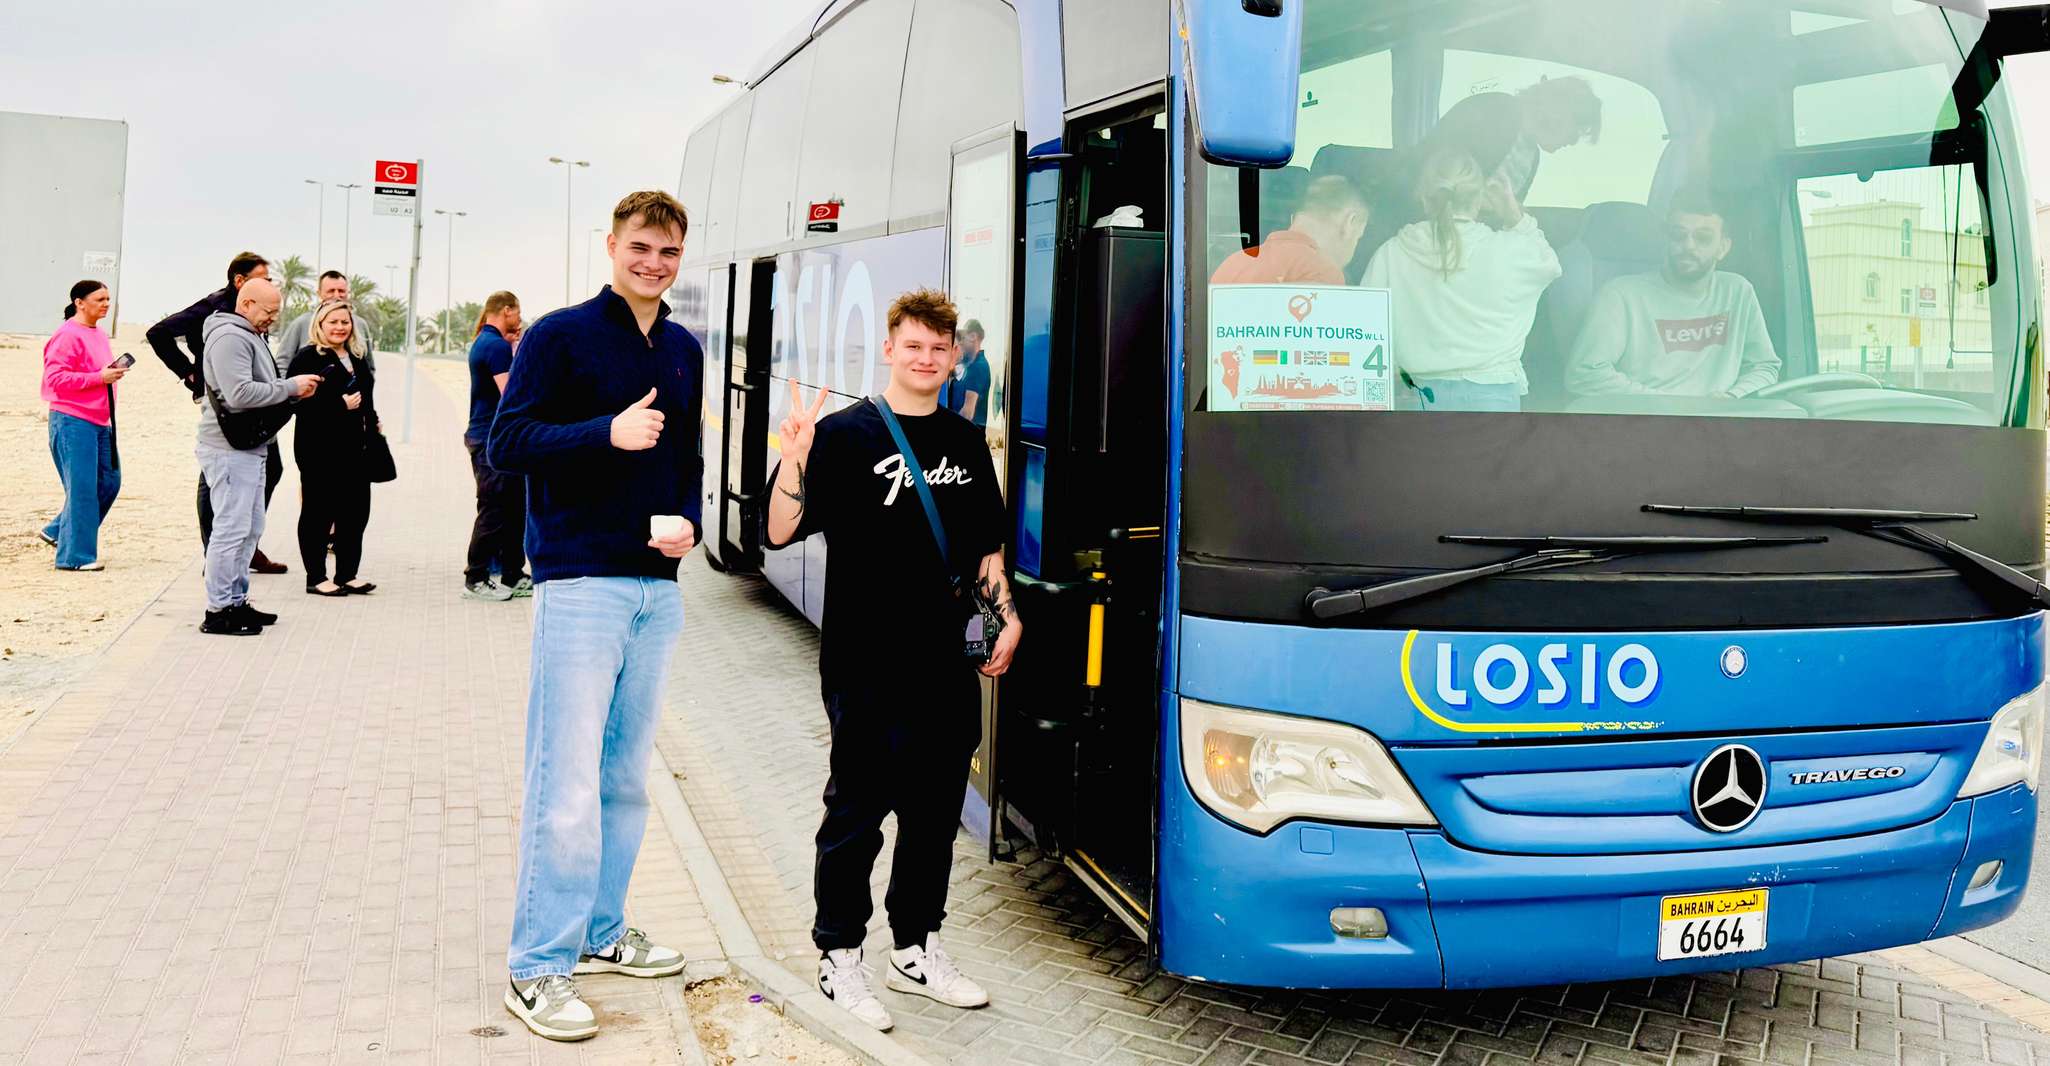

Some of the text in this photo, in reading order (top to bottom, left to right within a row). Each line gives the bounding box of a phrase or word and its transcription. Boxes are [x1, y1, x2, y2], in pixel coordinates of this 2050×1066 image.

[1216, 326, 1280, 339] BAHRAIN
[1284, 327, 1313, 339] FUN
[1317, 327, 1363, 340] TOURS
[1362, 344, 1388, 378] 4
[1436, 643, 1663, 709] LOSIO
[1790, 766, 1905, 785] TRAVEGO
[1671, 901, 1714, 916] BAHRAIN
[1717, 894, 1758, 913] البحرين
[1680, 917, 1744, 953] 6664
